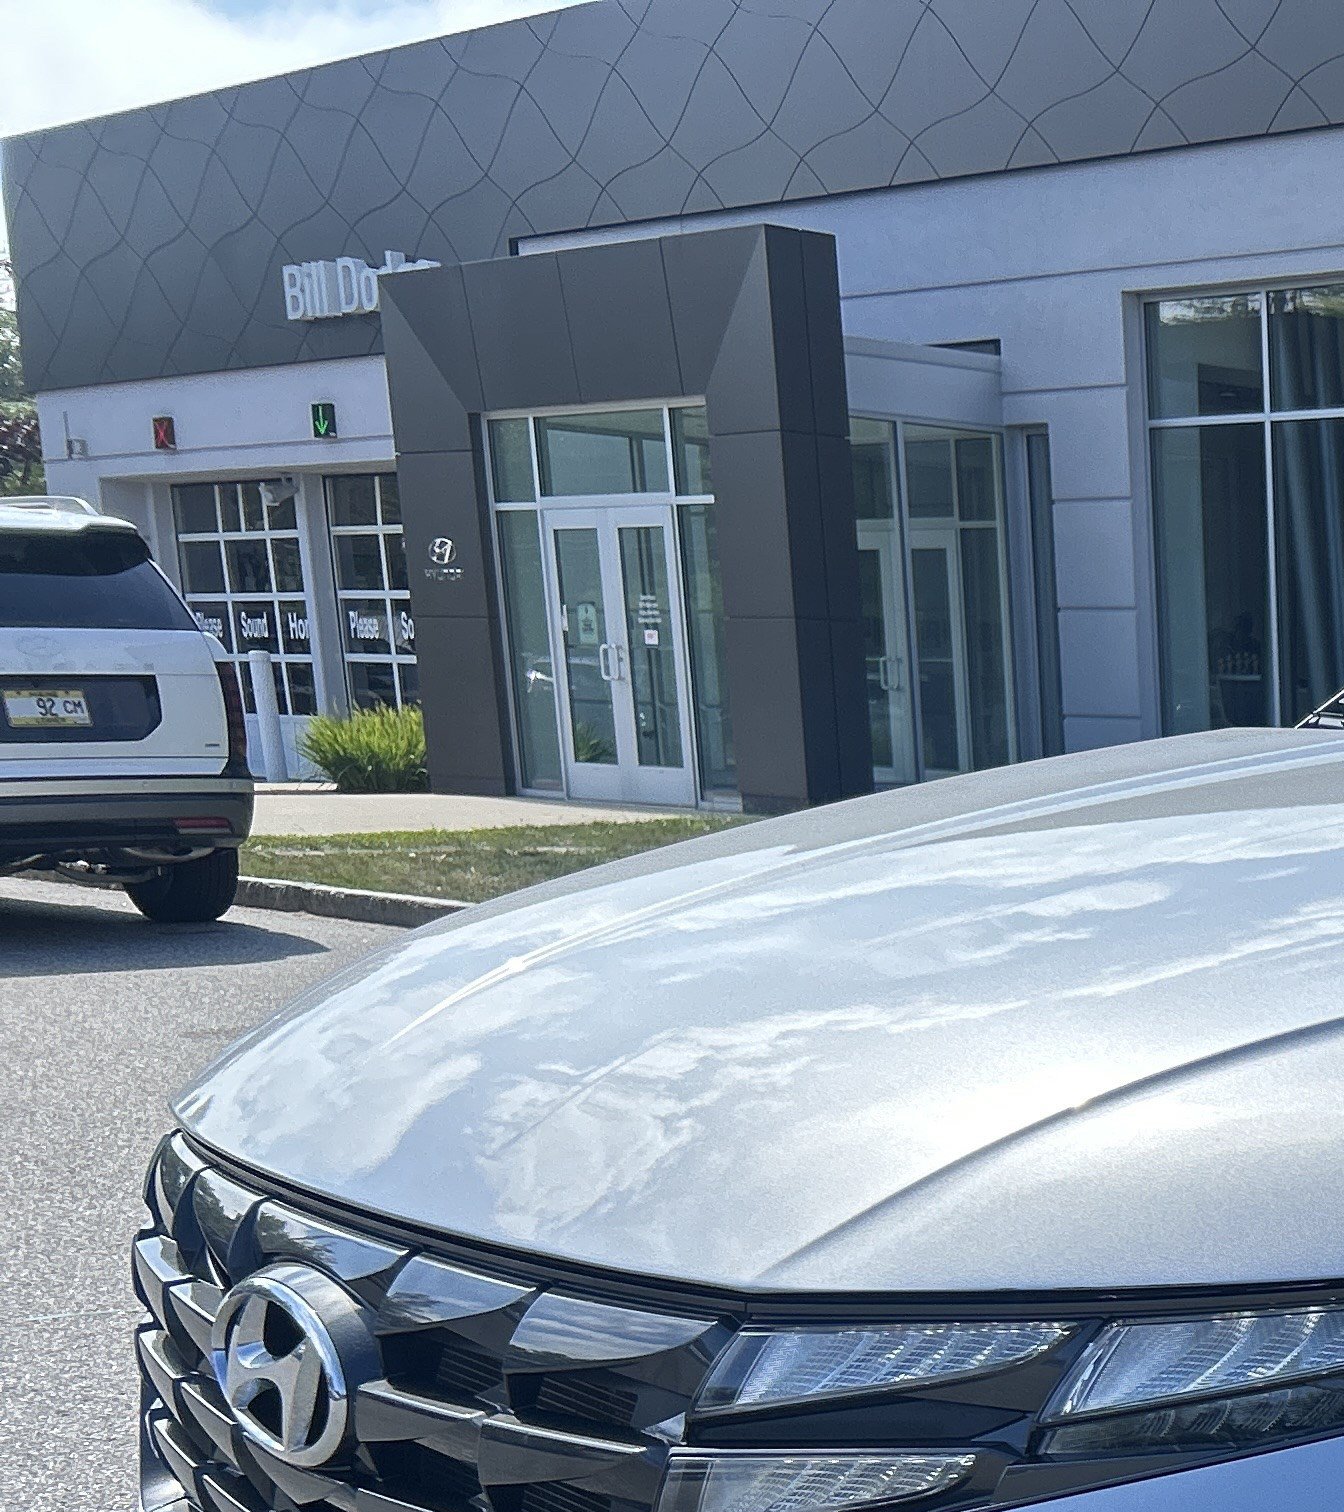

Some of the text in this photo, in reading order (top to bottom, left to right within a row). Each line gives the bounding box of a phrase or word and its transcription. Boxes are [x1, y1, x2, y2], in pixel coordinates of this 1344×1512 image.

[281, 260, 332, 321] Bill
[241, 611, 268, 639] Sound
[348, 611, 379, 639] Please
[36, 697, 59, 717] 92
